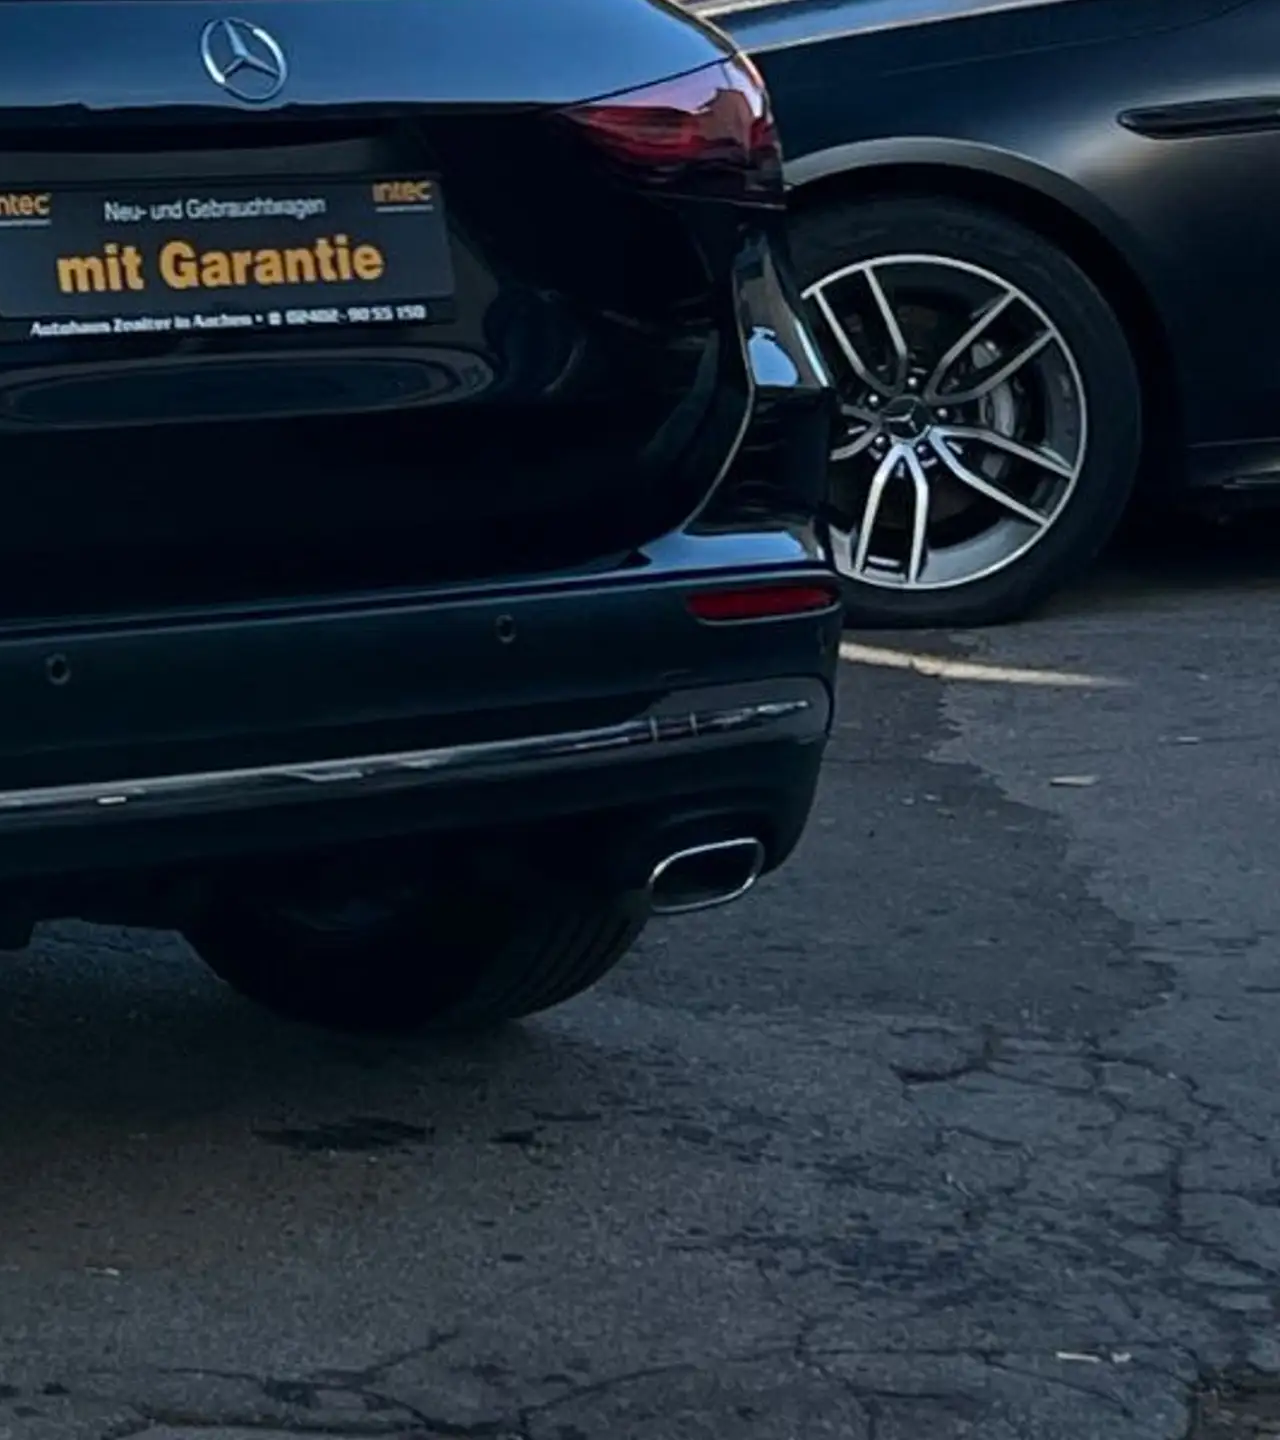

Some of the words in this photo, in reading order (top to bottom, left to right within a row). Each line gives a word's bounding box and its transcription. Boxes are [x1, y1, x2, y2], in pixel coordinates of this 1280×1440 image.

[103, 200, 147, 222] Neu-
[149, 198, 184, 221] und
[185, 196, 327, 221] Gebrauchtwagen
[55, 242, 145, 293] mit
[159, 234, 384, 289] Garantie
